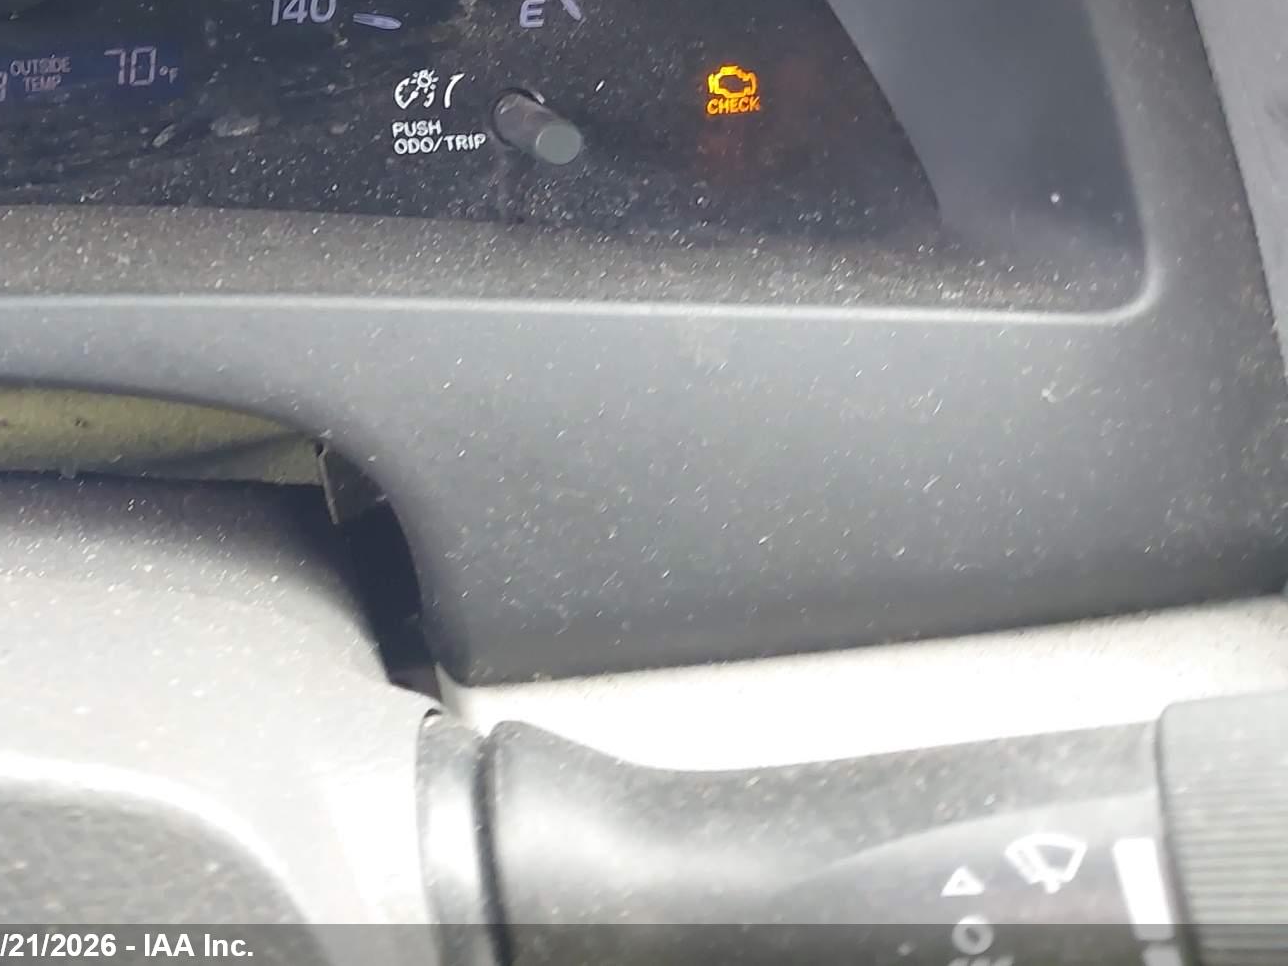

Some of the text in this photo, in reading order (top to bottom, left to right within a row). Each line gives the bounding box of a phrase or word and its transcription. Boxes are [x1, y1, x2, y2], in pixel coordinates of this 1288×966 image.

[11, 57, 72, 76] OUTSIDE
[23, 73, 63, 93] TEMP
[706, 95, 761, 115] CHECK
[392, 119, 442, 138] PUSH
[393, 133, 487, 155] ODO/TRIP
